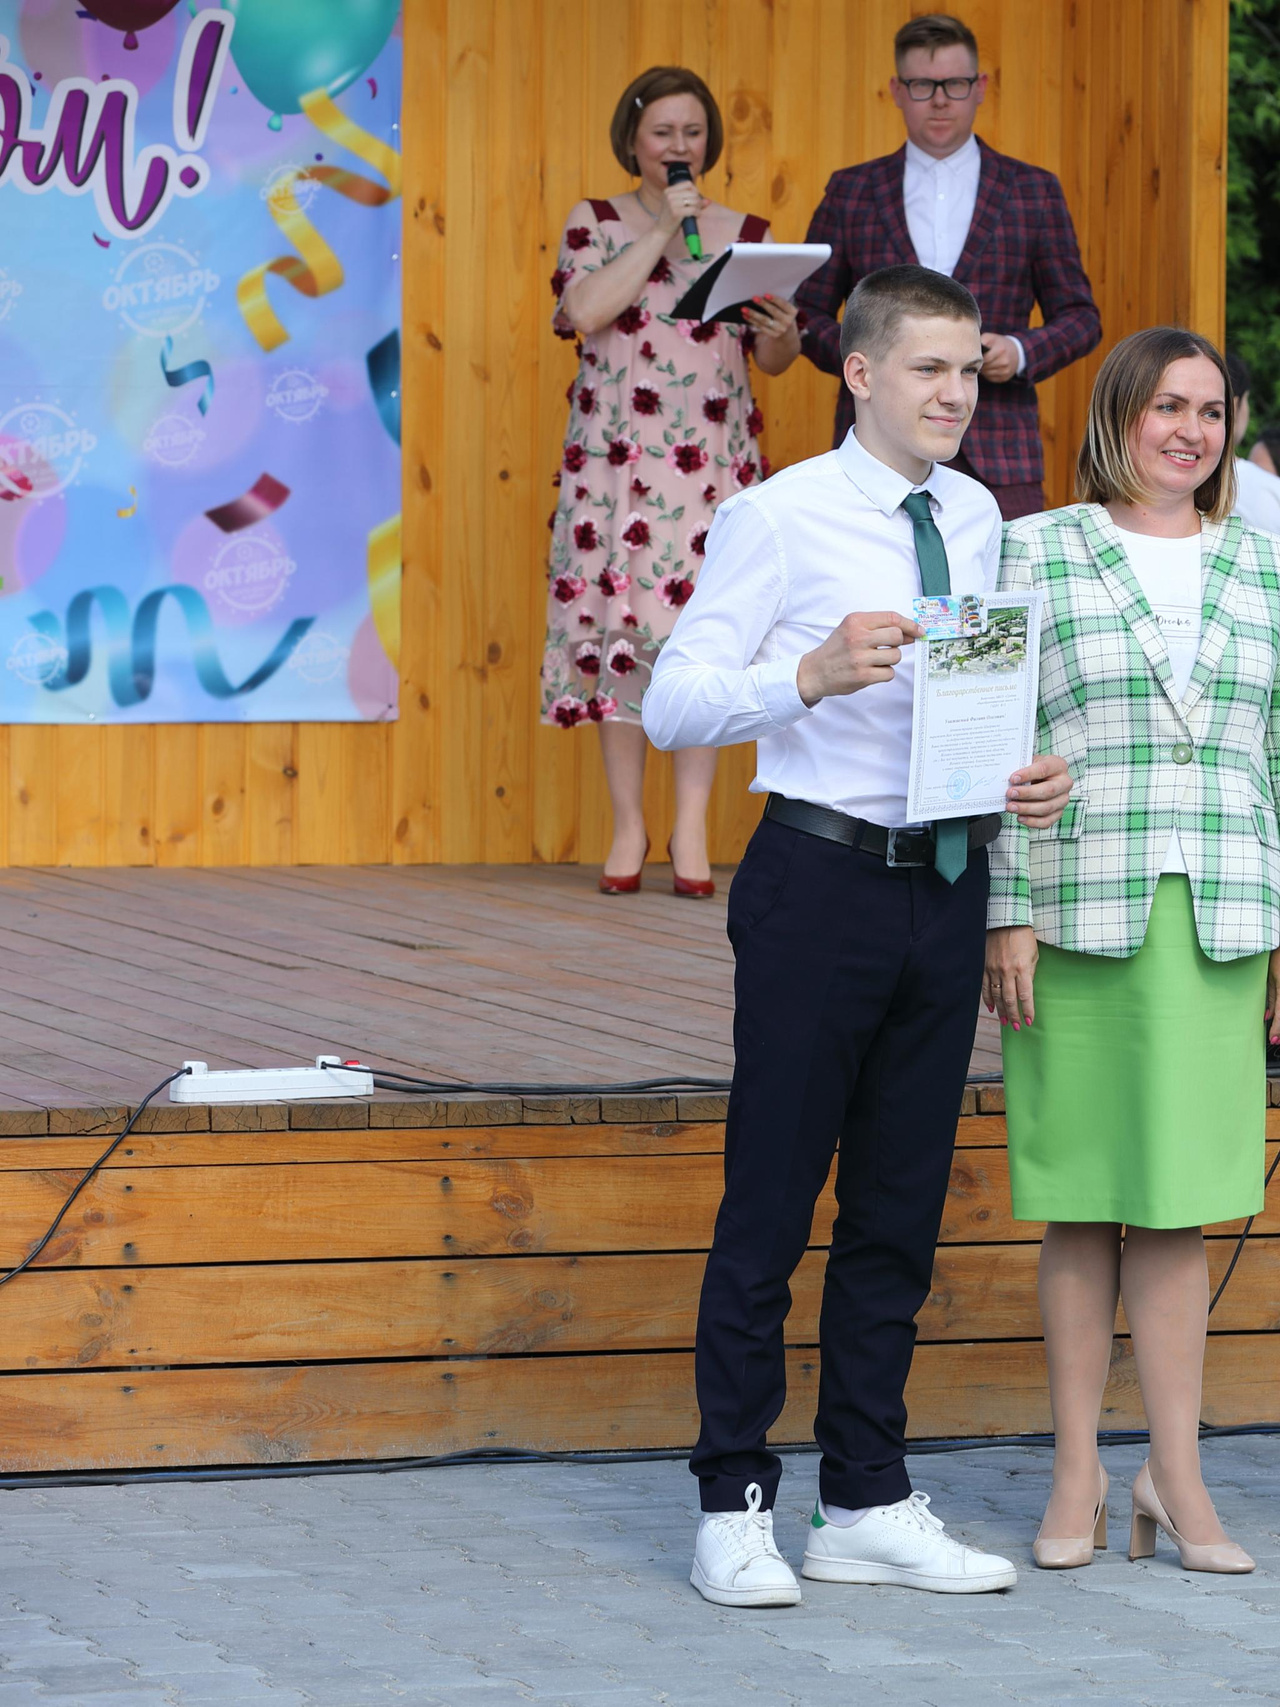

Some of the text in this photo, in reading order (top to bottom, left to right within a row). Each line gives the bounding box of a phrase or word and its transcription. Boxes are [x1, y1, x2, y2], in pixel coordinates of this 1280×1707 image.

[102, 268, 220, 311] ОКТЯБРЬ
[265, 384, 329, 407] ОКТЯБРЬ
[142, 428, 206, 452] ОКТЯБРЬ
[204, 557, 297, 590] ОКТЯБРЬ
[6, 647, 68, 670] ОКТЯБРЬ
